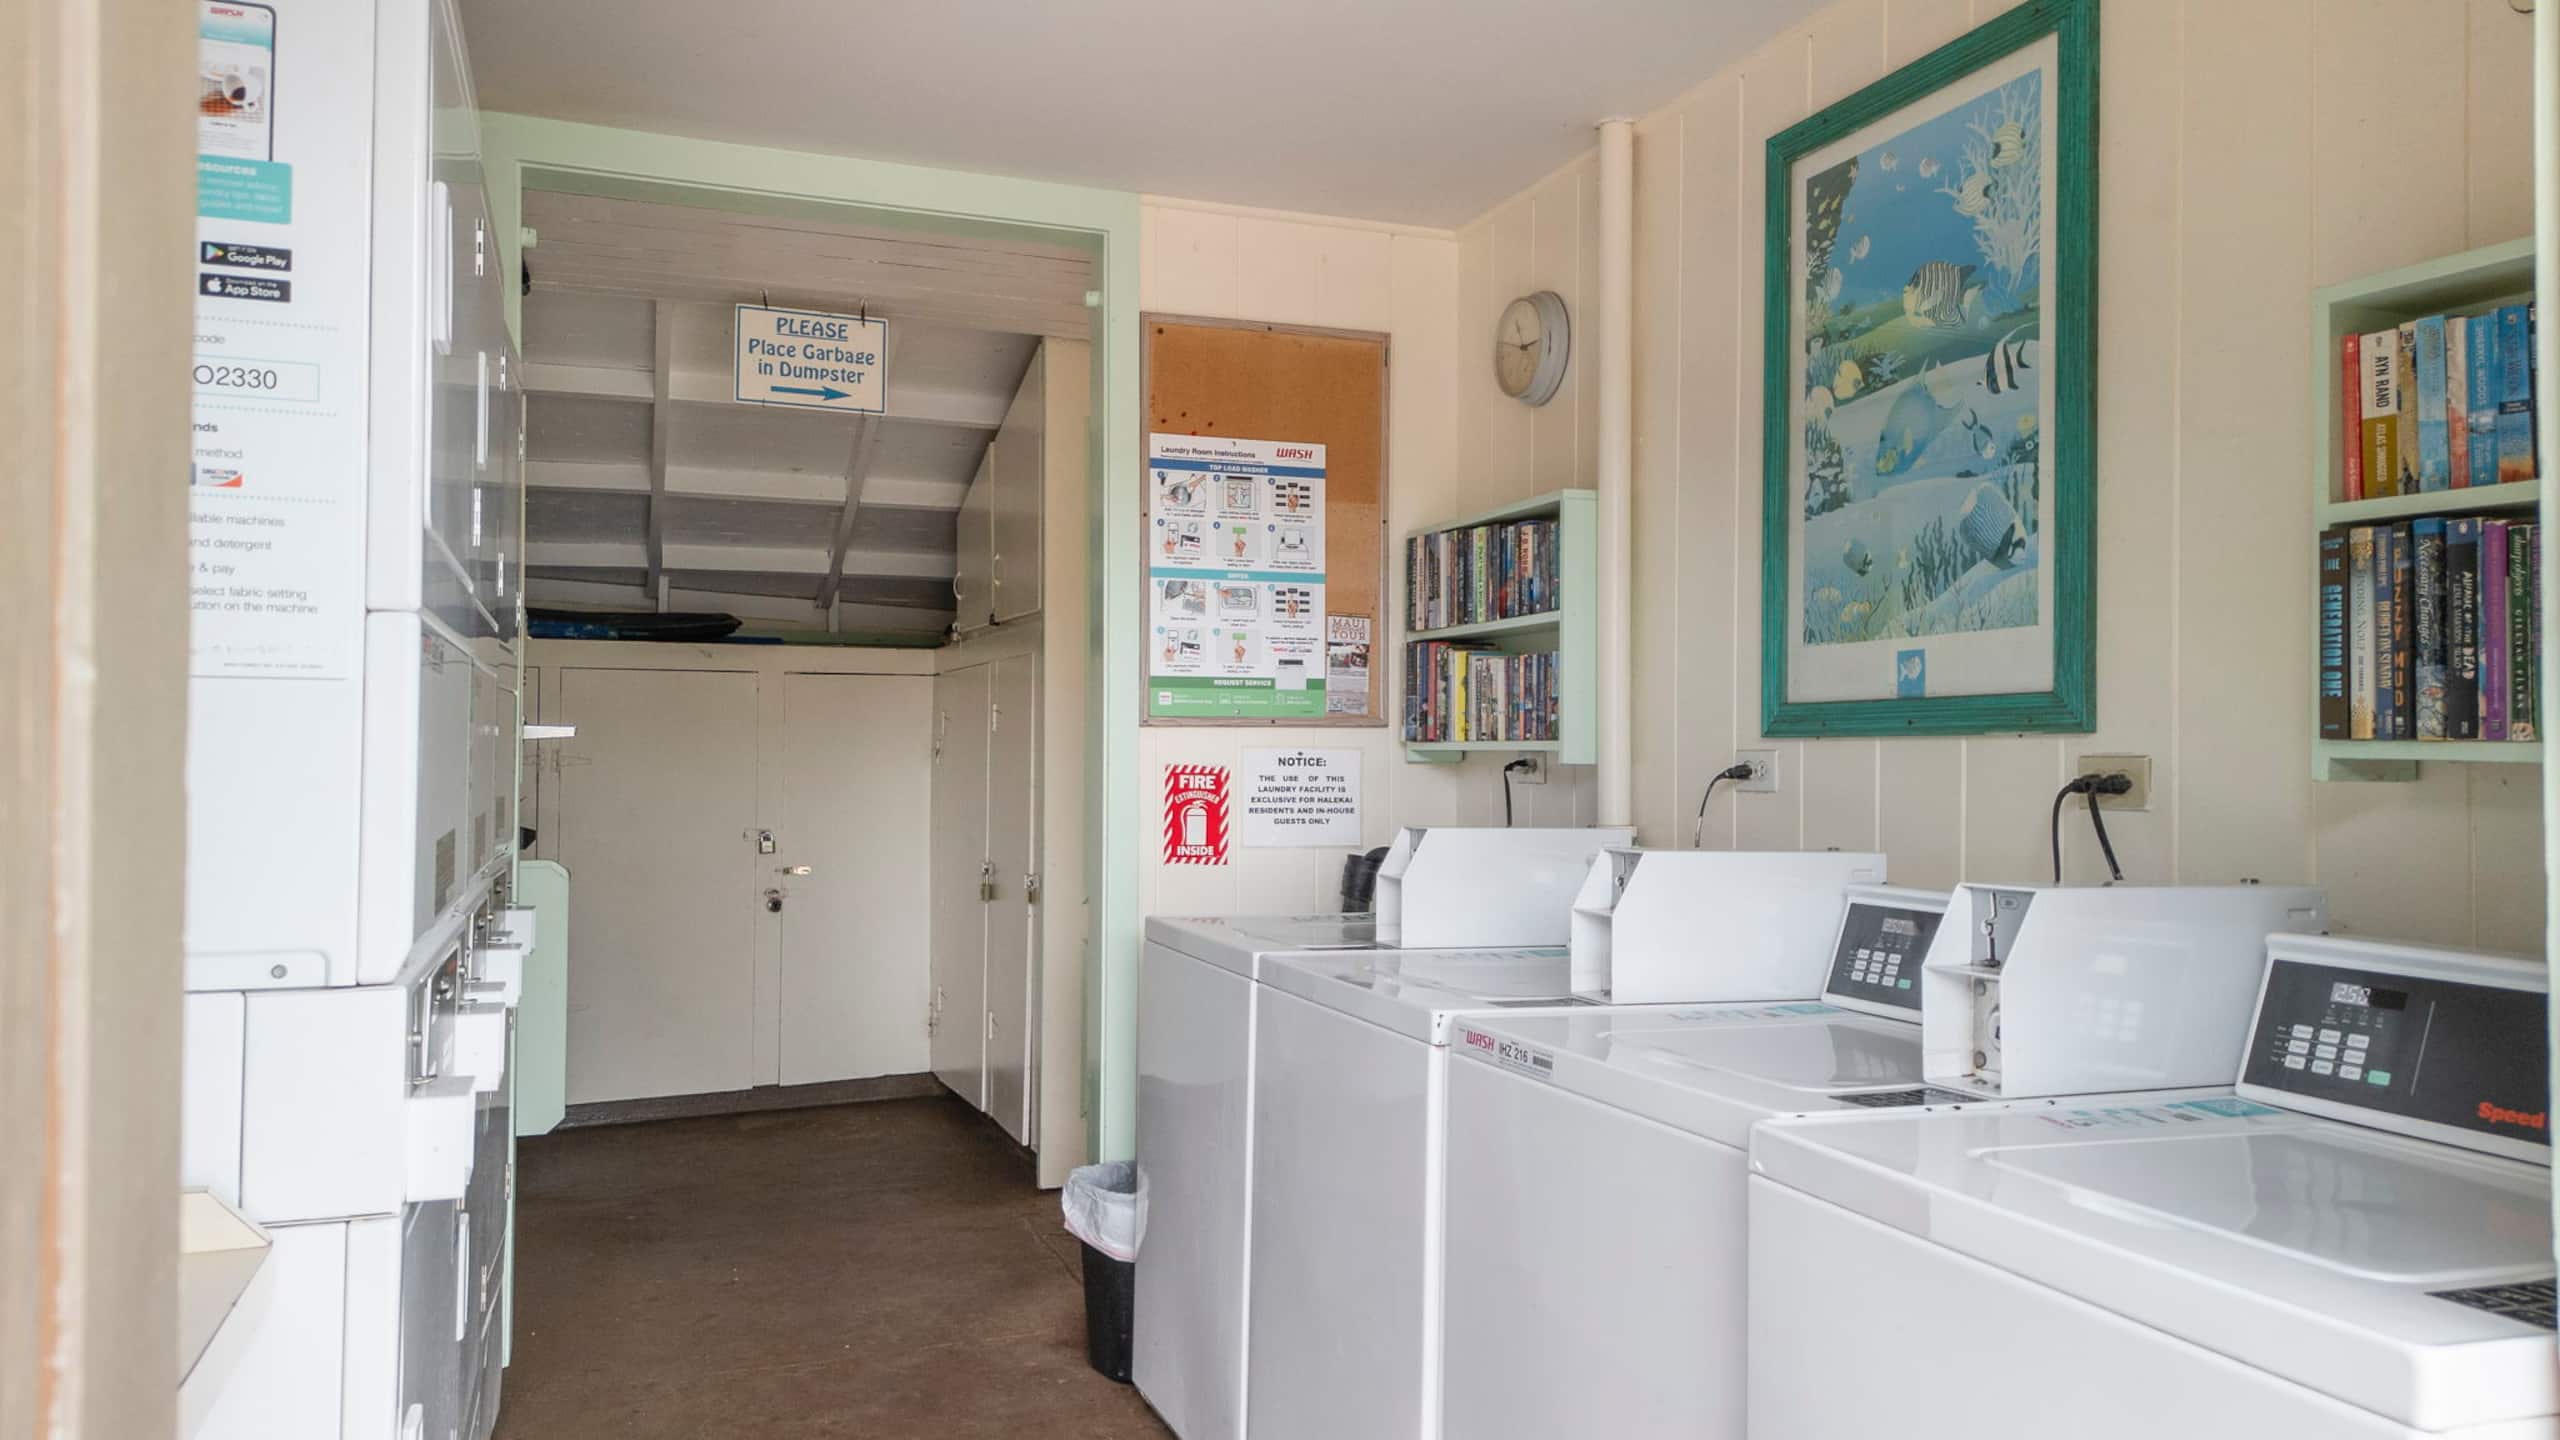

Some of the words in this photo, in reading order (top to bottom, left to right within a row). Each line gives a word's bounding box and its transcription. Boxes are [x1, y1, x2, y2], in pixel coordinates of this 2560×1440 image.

[227, 252, 264, 265] Google
[266, 255, 287, 267] Play
[225, 284, 248, 296] App
[250, 286, 280, 298] Store
[776, 317, 849, 340] PLEASE
[748, 337, 797, 358] Place
[802, 343, 876, 366] Garbage
[758, 358, 774, 376] in
[780, 361, 865, 385] Dumpster
[2375, 355, 2390, 377] AYN
[2375, 379, 2391, 409] RAND
[195, 448, 242, 458] method
[1160, 445, 1190, 456] Laundry
[1192, 447, 1213, 456] Room
[1214, 448, 1255, 458] Instructions
[1276, 447, 1313, 459] WASH
[226, 514, 285, 527] machines
[213, 538, 272, 551] detergent
[212, 564, 235, 576] pay
[2417, 538, 2432, 597] Necessary
[229, 585, 263, 598] fabric
[266, 588, 307, 601] setting
[223, 602, 241, 611] on
[243, 601, 262, 612] the
[266, 603, 318, 615] machine
[1332, 617, 1366, 628] MAUI
[2322, 584, 2343, 667] GENERATION
[2417, 598, 2433, 645] Changes
[1332, 630, 1366, 640] TOUR
[2461, 646, 2476, 680] DEAD
[2322, 671, 2343, 697] ONE
[2515, 669, 2524, 709] FLYNN
[1278, 757, 1326, 767] NOTICE:
[1179, 774, 1216, 789] FIRE
[1177, 845, 1214, 856] INSIDE
[1466, 1029, 1496, 1052] WASH
[1513, 1047, 1529, 1064] 216
[2477, 1101, 2546, 1129] Speed
